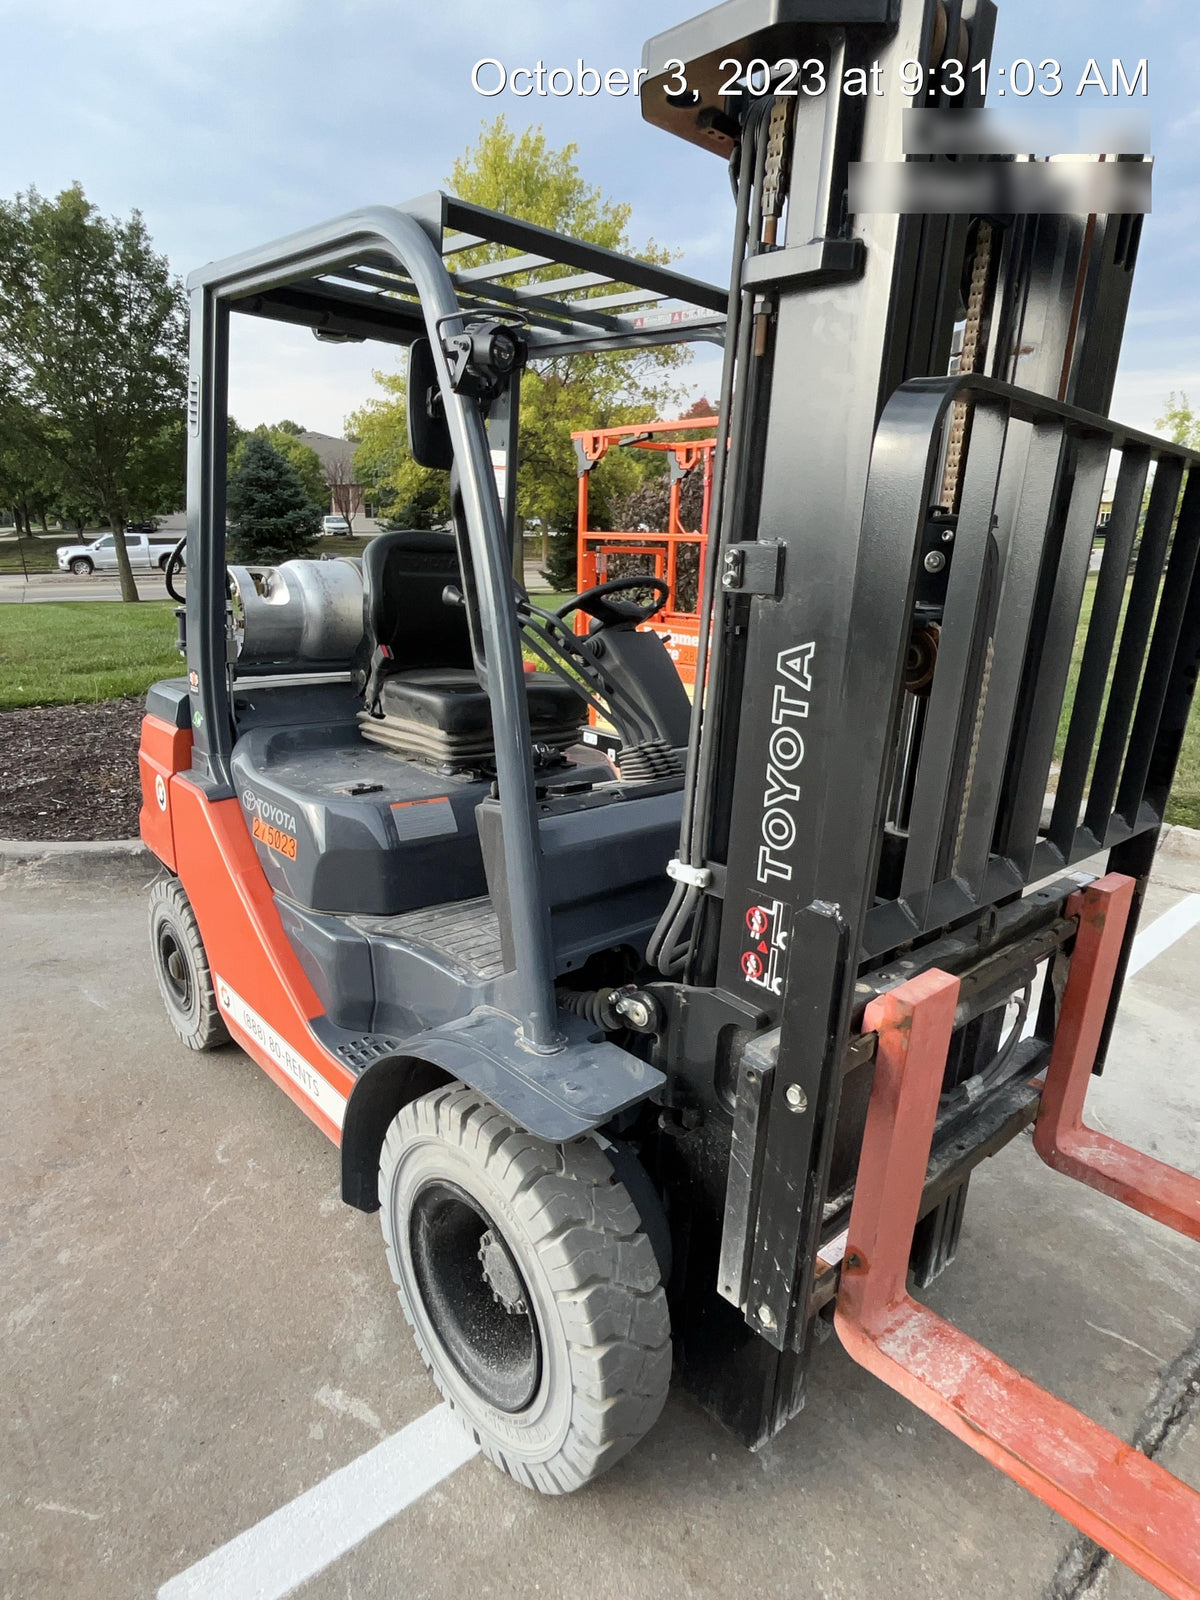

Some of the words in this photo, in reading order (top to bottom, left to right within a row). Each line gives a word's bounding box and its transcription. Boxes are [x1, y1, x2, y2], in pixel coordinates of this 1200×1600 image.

[757, 641, 816, 883] TOYOTA
[253, 818, 296, 859] 275023
[256, 798, 297, 834] TOYOTA
[243, 1010, 267, 1042] (888)
[269, 1036, 320, 1097] 80-RENTS
